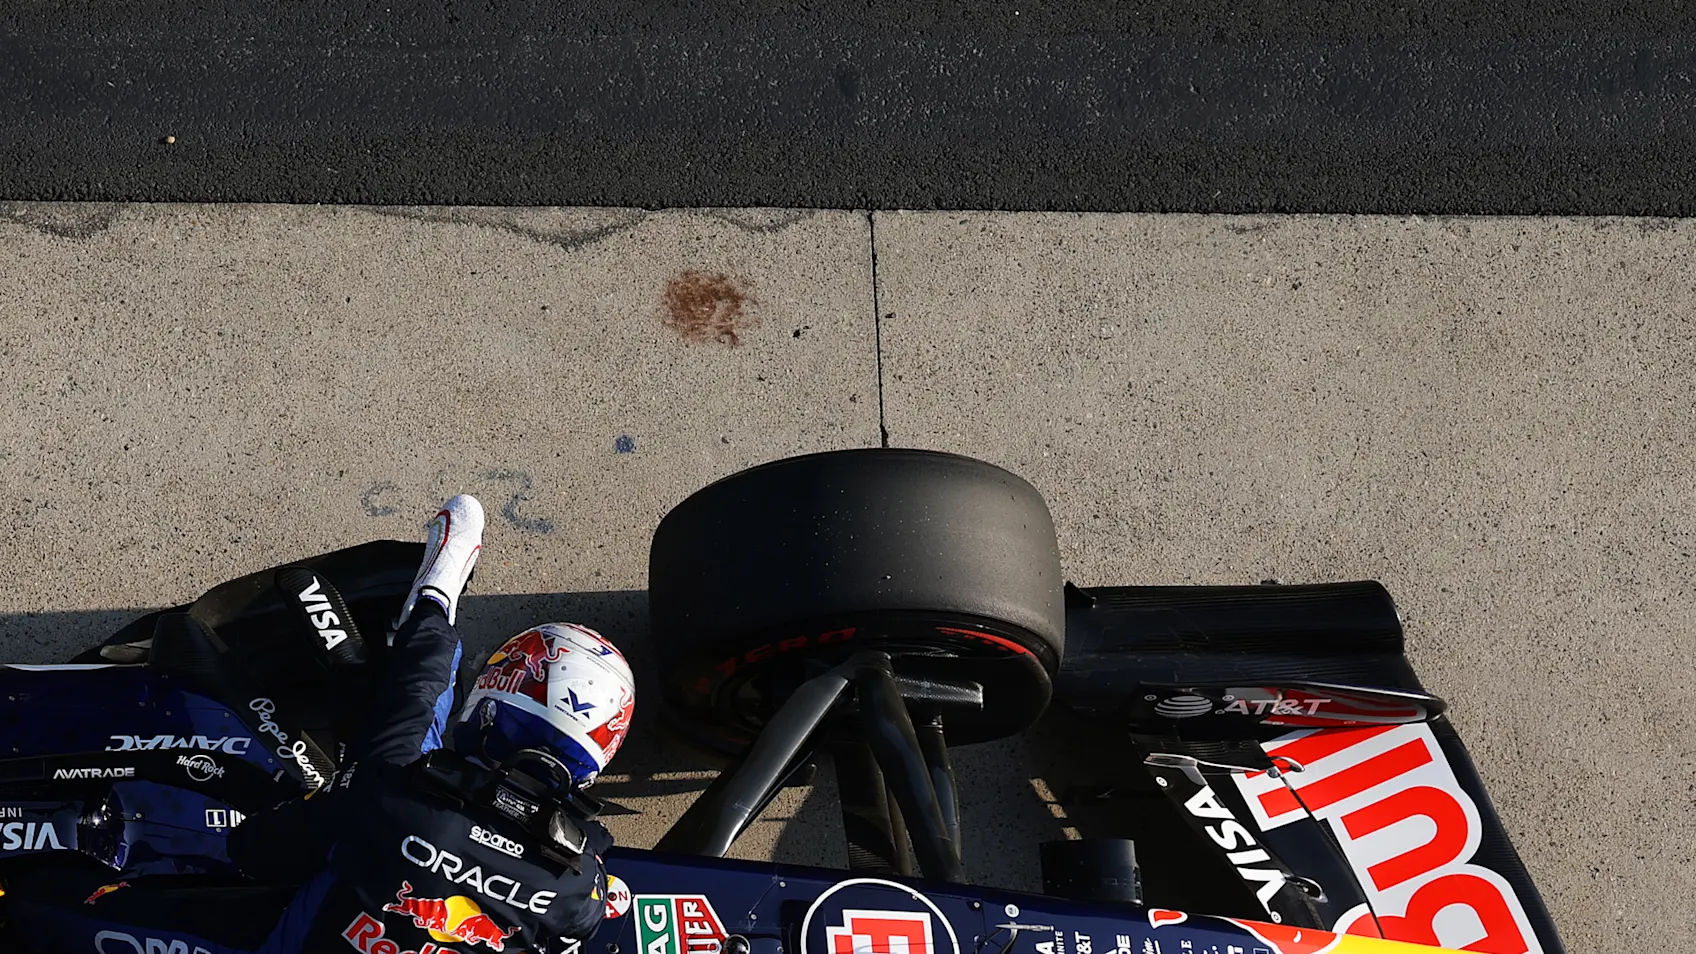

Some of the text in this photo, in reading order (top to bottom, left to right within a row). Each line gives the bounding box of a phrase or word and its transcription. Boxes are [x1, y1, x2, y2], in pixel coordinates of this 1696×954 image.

[297, 576, 349, 651] VISA
[1224, 699, 1331, 715] AT&T
[105, 734, 251, 755] DAMAC
[249, 698, 325, 788] Pepe Jean
[53, 767, 135, 780] AVATRADE
[176, 755, 225, 778] Hard Rock
[470, 825, 524, 856] sparco
[1184, 785, 1286, 915] VISA
[401, 835, 557, 915] ORACLE
[618, 891, 628, 901] N
